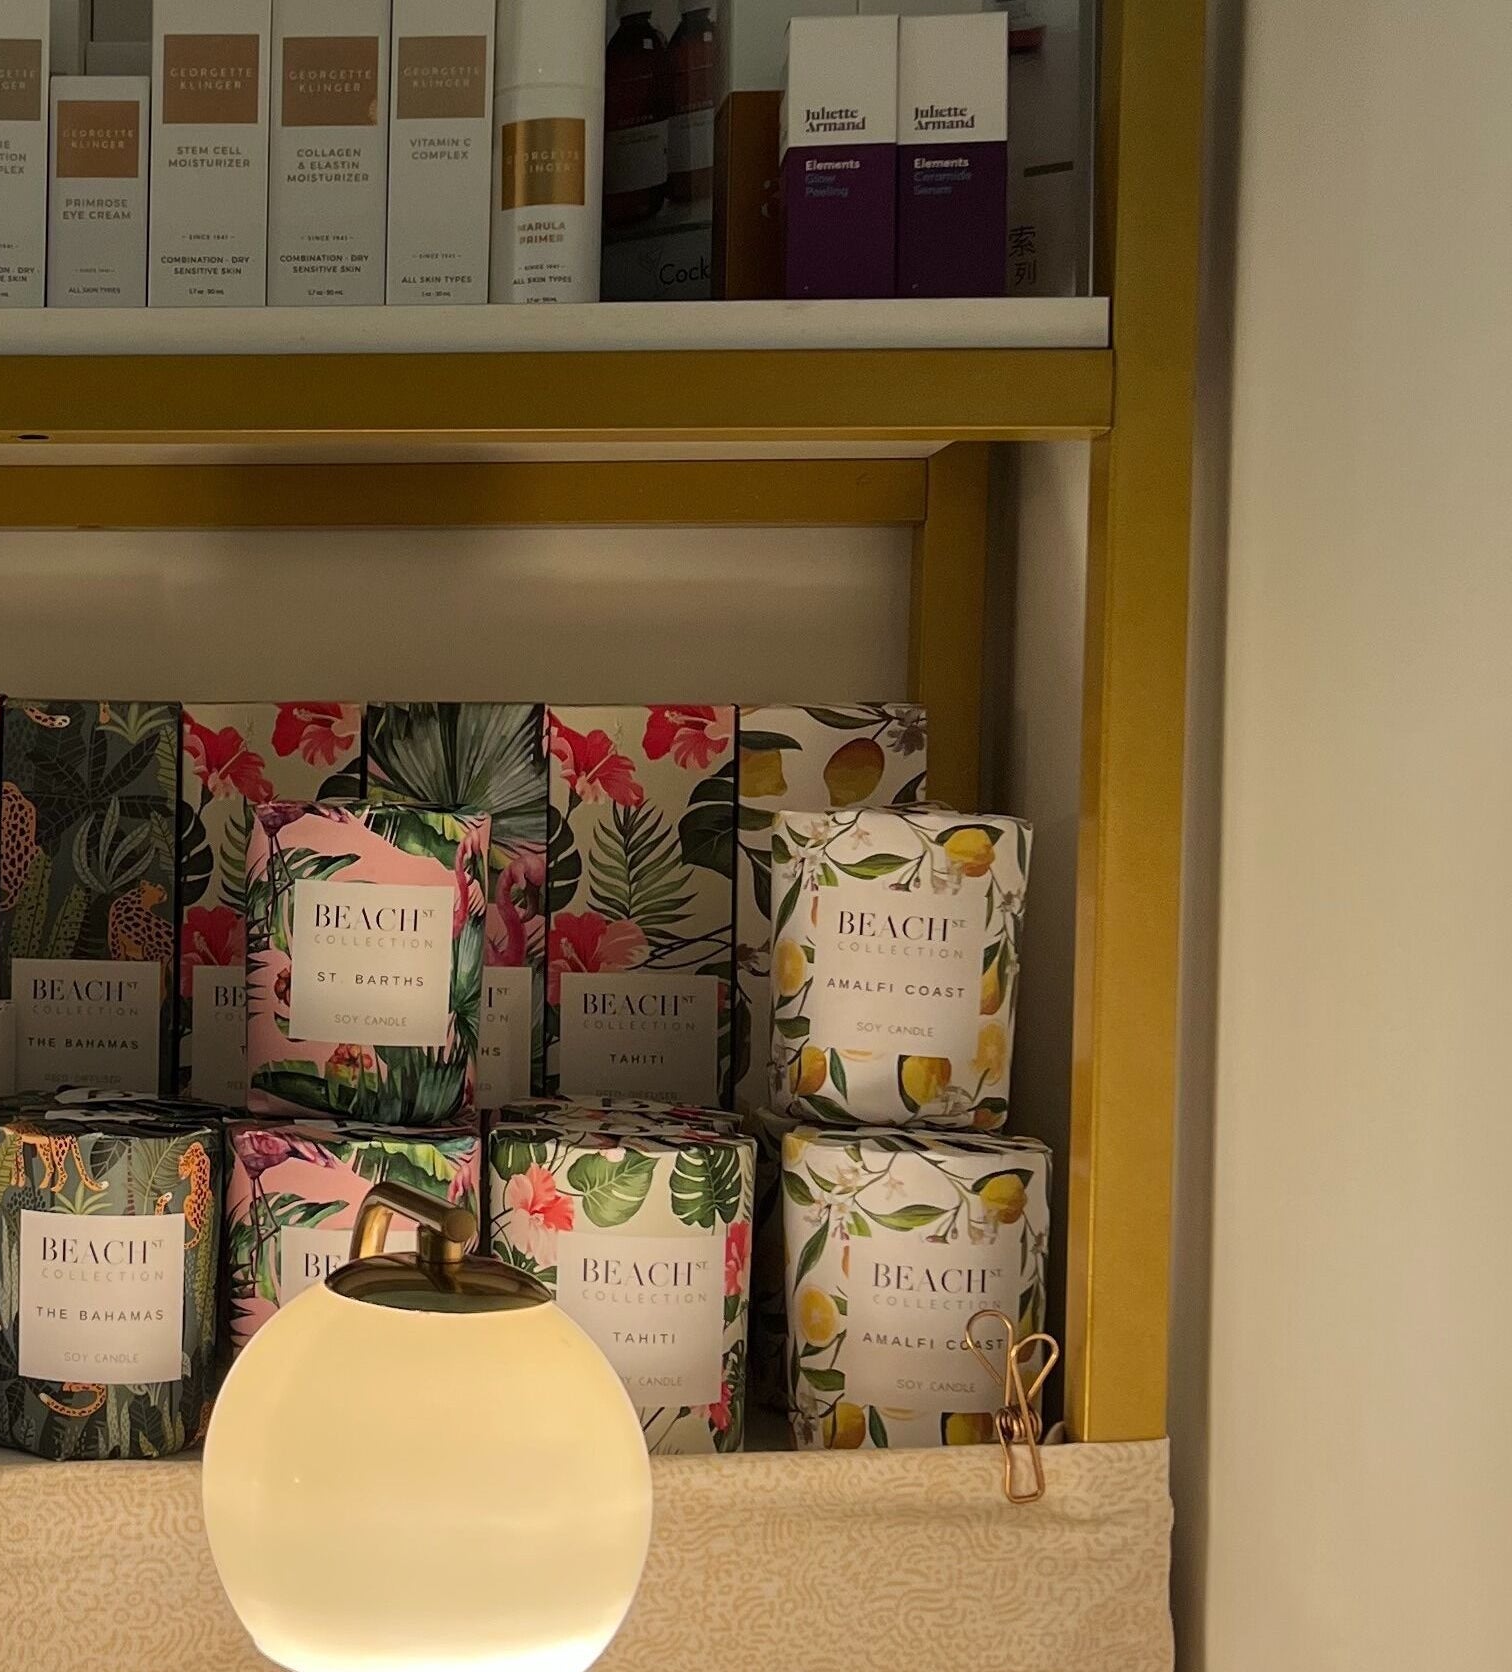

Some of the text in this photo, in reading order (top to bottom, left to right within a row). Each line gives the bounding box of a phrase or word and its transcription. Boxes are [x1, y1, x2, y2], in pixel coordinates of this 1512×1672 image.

[170, 67, 253, 78] GEORGETTE
[289, 69, 372, 81] GEORGETTE
[180, 80, 242, 90] KLINGER
[299, 82, 361, 93] KLINGER
[806, 107, 858, 121] Juliette
[914, 105, 968, 120] Juliette
[806, 117, 866, 132] Armand
[915, 115, 975, 131] Armand
[410, 138, 472, 147] VITAMIN C
[177, 146, 242, 155] STEM CELL
[297, 148, 362, 158] COLLAGEN
[411, 151, 469, 160] COMPLEX
[168, 159, 251, 168] MOISTURIZER
[310, 161, 360, 170] ELASTIN
[805, 159, 860, 171] Elements
[914, 157, 970, 169] Elements
[287, 173, 370, 183] MOISTURIZER
[65, 198, 128, 208] PRIMROSE
[62, 211, 131, 220] EYE CREAM
[161, 256, 250, 264] COMBINATION DRY
[18, 266, 35, 274] DRY
[173, 267, 242, 275] SENSITIVE SKIN
[292, 265, 361, 273] SENSITIVE SKIN
[315, 903, 418, 932] BEACH
[838, 911, 948, 942] BEACH
[314, 934, 433, 949] COLLECTION
[838, 941, 964, 959] COLLECTION
[355, 974, 424, 987] BARTHS
[32, 979, 123, 1002] BEACH
[827, 978, 965, 998] AMALFI COAST
[32, 1004, 138, 1016] COLLECTION
[583, 992, 679, 1017] BEACH
[334, 1014, 407, 1027] SOY CANDLE
[583, 1020, 695, 1031] COLLECTION
[856, 1021, 934, 1037] SOY CANDLE
[28, 1037, 138, 1049] THE BAHAMAS
[609, 1054, 665, 1065] TAHITI
[42, 1237, 147, 1265] BEACH
[41, 1267, 164, 1282] COLLECTION
[583, 1257, 691, 1287] BEACH
[873, 1263, 986, 1293] BEACH
[582, 1289, 707, 1304] COLLECTION
[873, 1294, 1001, 1310] COLLECTION
[36, 1306, 164, 1322] THE BAHAMAS
[613, 1332, 676, 1344] TAHITI
[862, 1332, 1004, 1351] AMALFI COAST
[64, 1352, 139, 1364] SOY CANDLE
[639, 1377, 683, 1387] CANDLE
[896, 1378, 976, 1393] SOY CANDLE
